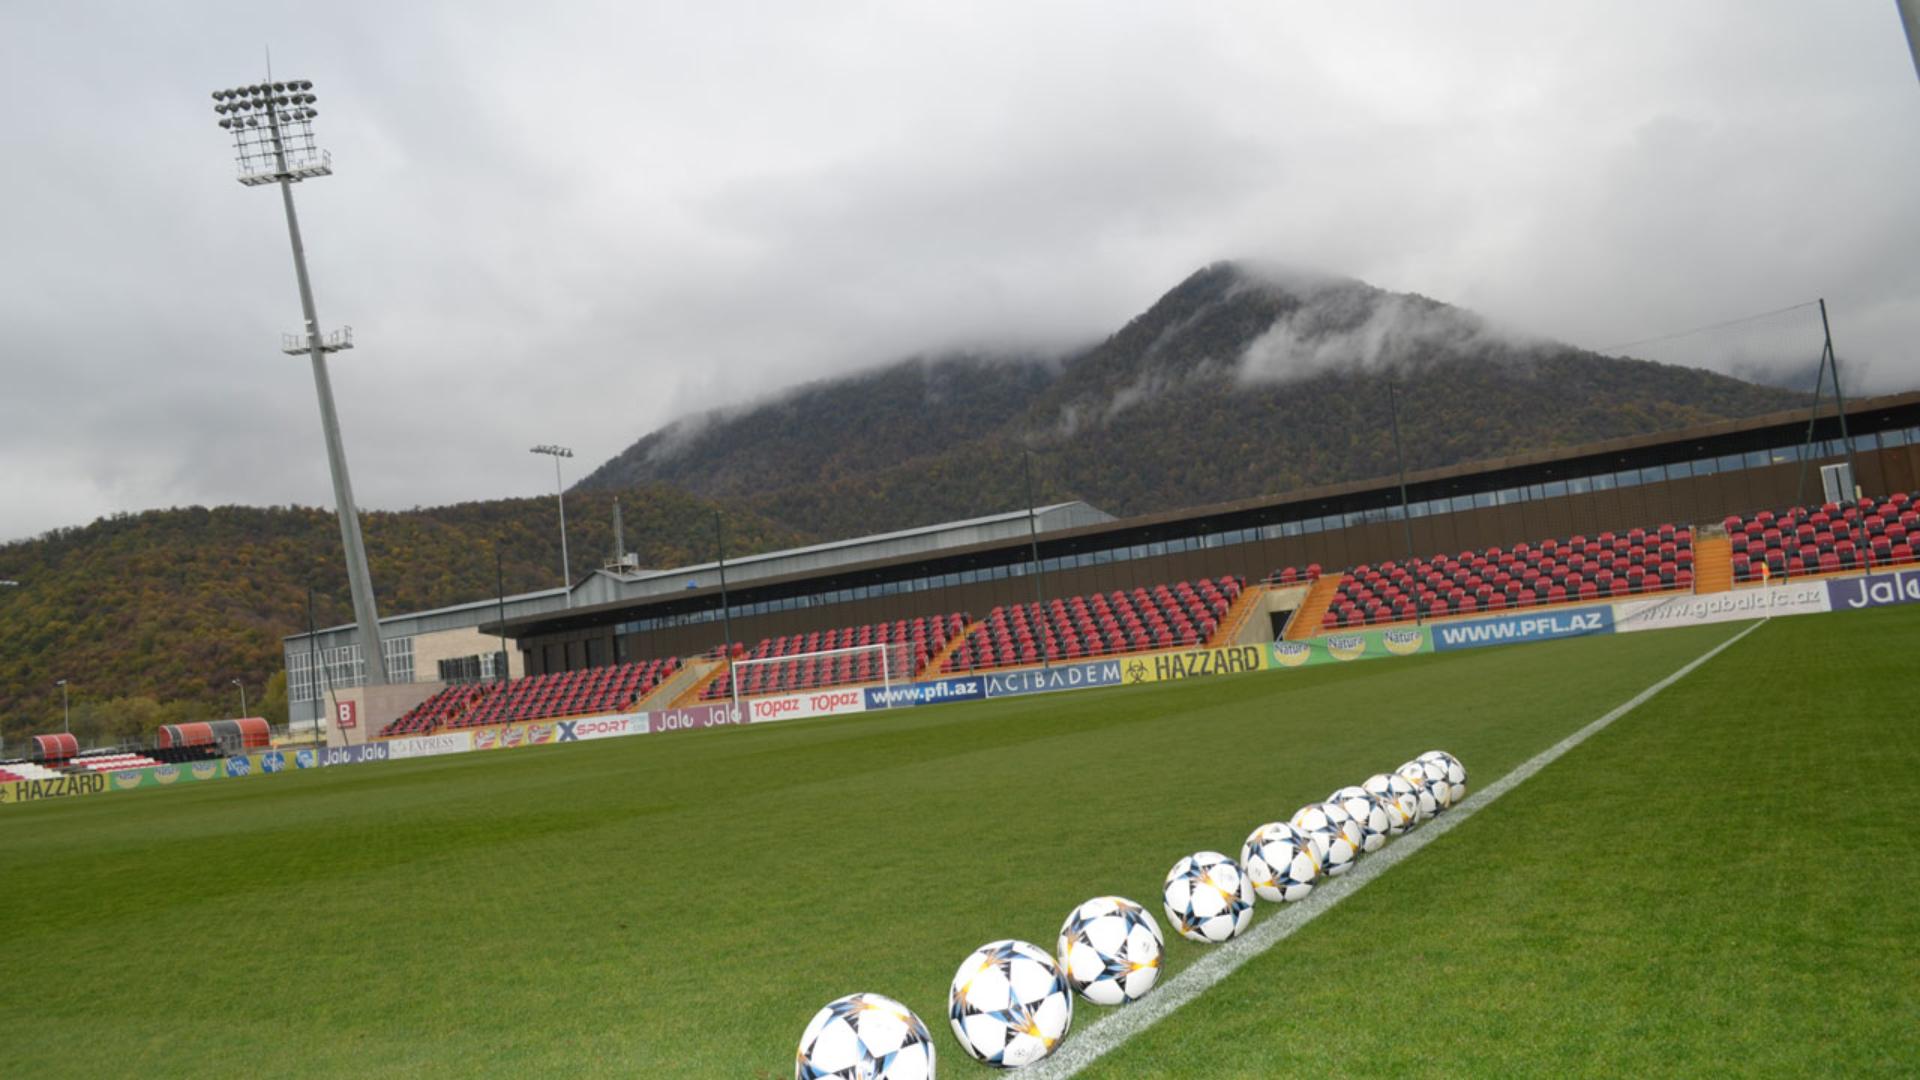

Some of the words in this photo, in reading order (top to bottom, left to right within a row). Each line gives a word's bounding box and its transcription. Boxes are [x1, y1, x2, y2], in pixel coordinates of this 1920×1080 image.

[1442, 608, 1603, 645] WWW.PFL.AZ
[1155, 646, 1260, 680] HAZZARD
[989, 663, 1120, 693] ACIBADEM
[872, 681, 978, 703] www.pfl.az
[340, 704, 351, 721] B
[657, 709, 694, 732] Jale
[16, 773, 105, 800] HAZZARD
